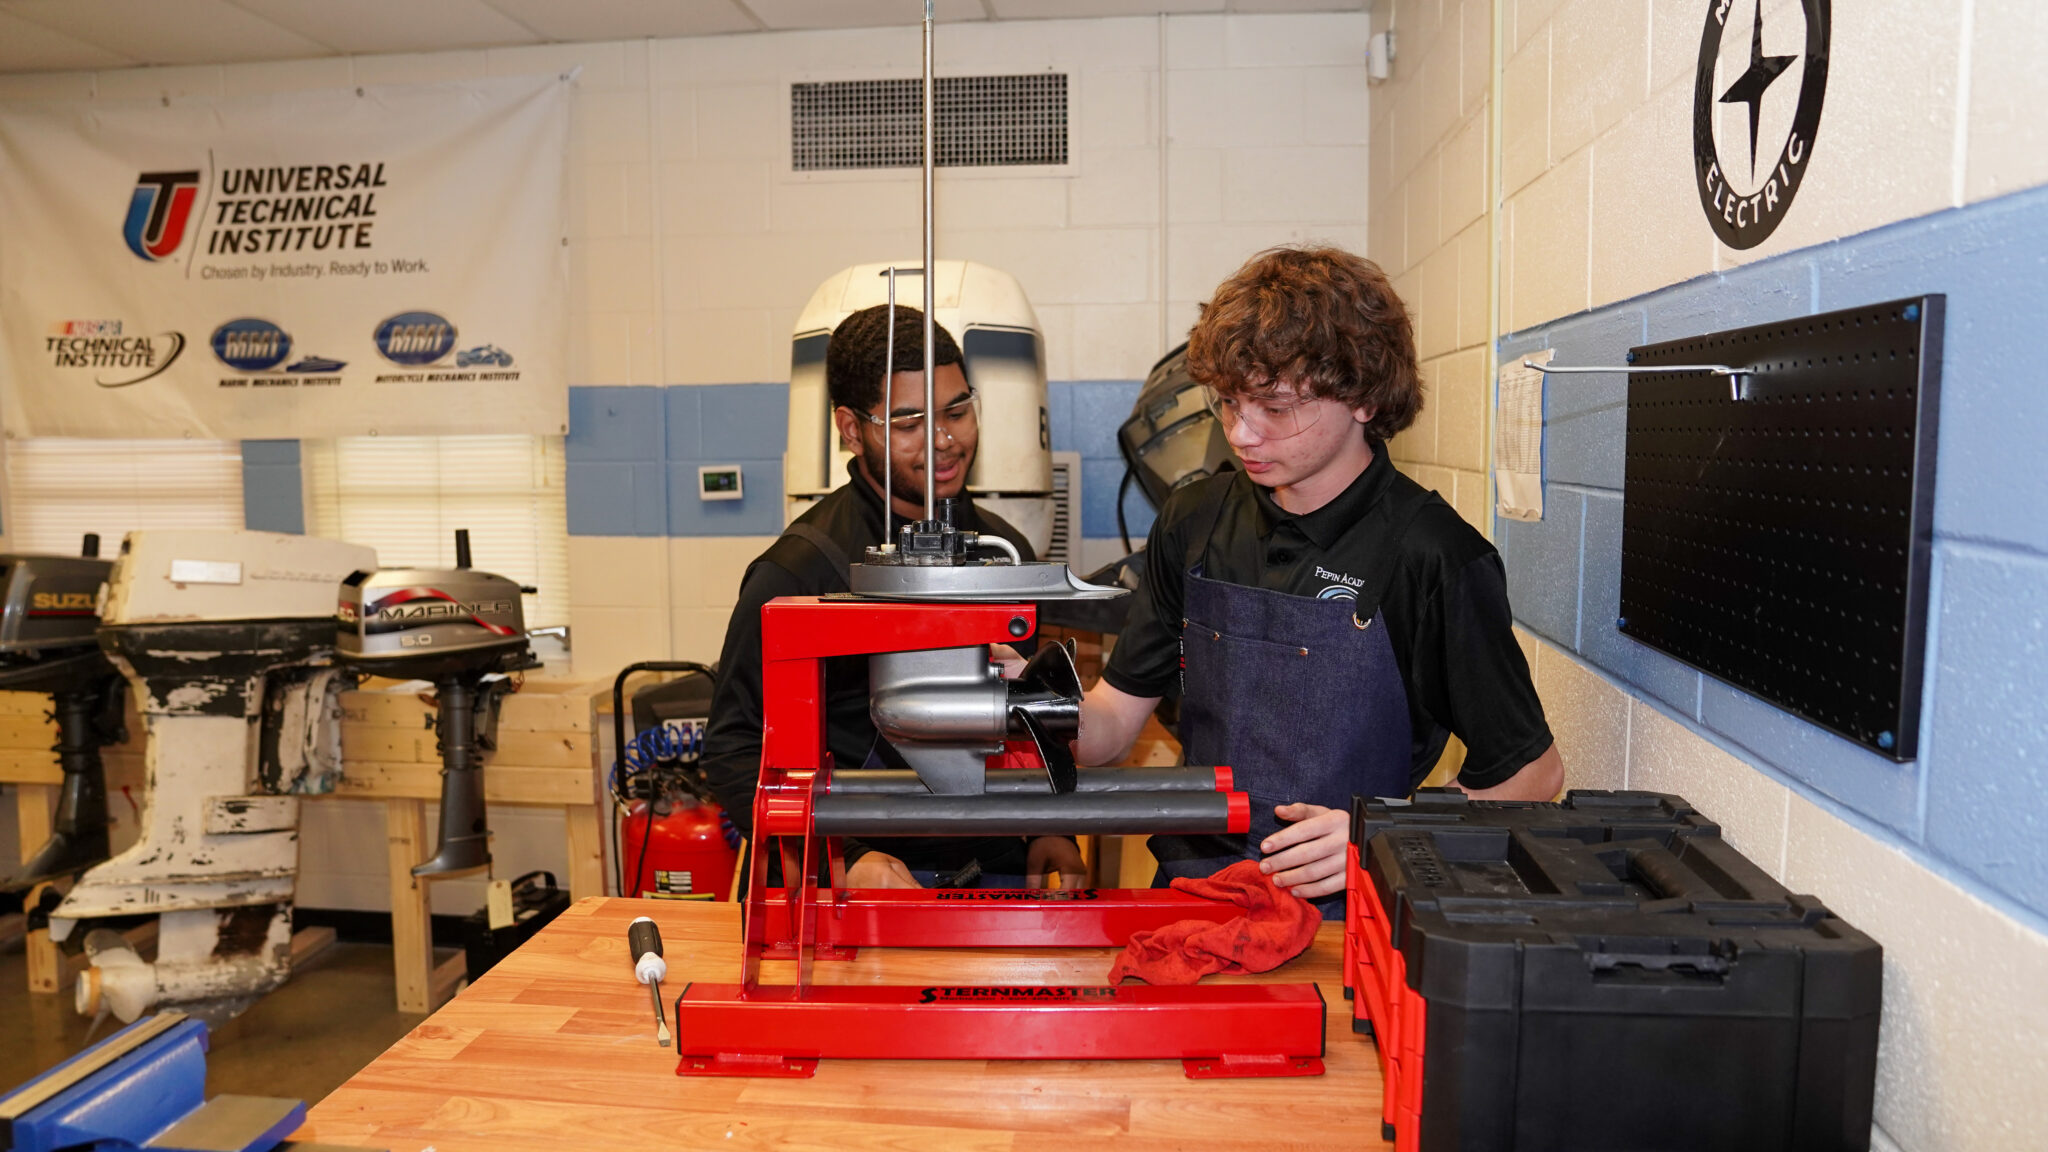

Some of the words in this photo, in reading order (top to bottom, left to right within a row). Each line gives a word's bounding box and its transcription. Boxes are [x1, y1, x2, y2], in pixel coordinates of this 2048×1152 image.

[222, 163, 387, 195] UNIVERSAL
[1705, 132, 1803, 228] ELECTRIC
[216, 193, 377, 225] TECHNICAL
[208, 222, 374, 255] INSTITUTE
[201, 265, 248, 280] Chosen
[251, 264, 268, 281] by
[270, 263, 326, 279] Industry.
[330, 261, 371, 278] Ready
[374, 261, 388, 275] to
[391, 259, 430, 274] Work.
[46, 337, 155, 352] TECHNICAL
[225, 331, 279, 358] MMI
[387, 324, 446, 353] MMI
[55, 352, 155, 367] INSTITUTE
[302, 377, 342, 386] INSTITUTE
[427, 373, 476, 382] MECHANICS
[479, 372, 520, 381] INSTITUTE
[379, 601, 513, 622] MARINER
[401, 634, 432, 647] 5.0
[918, 987, 1117, 1003] STERNMASTER
